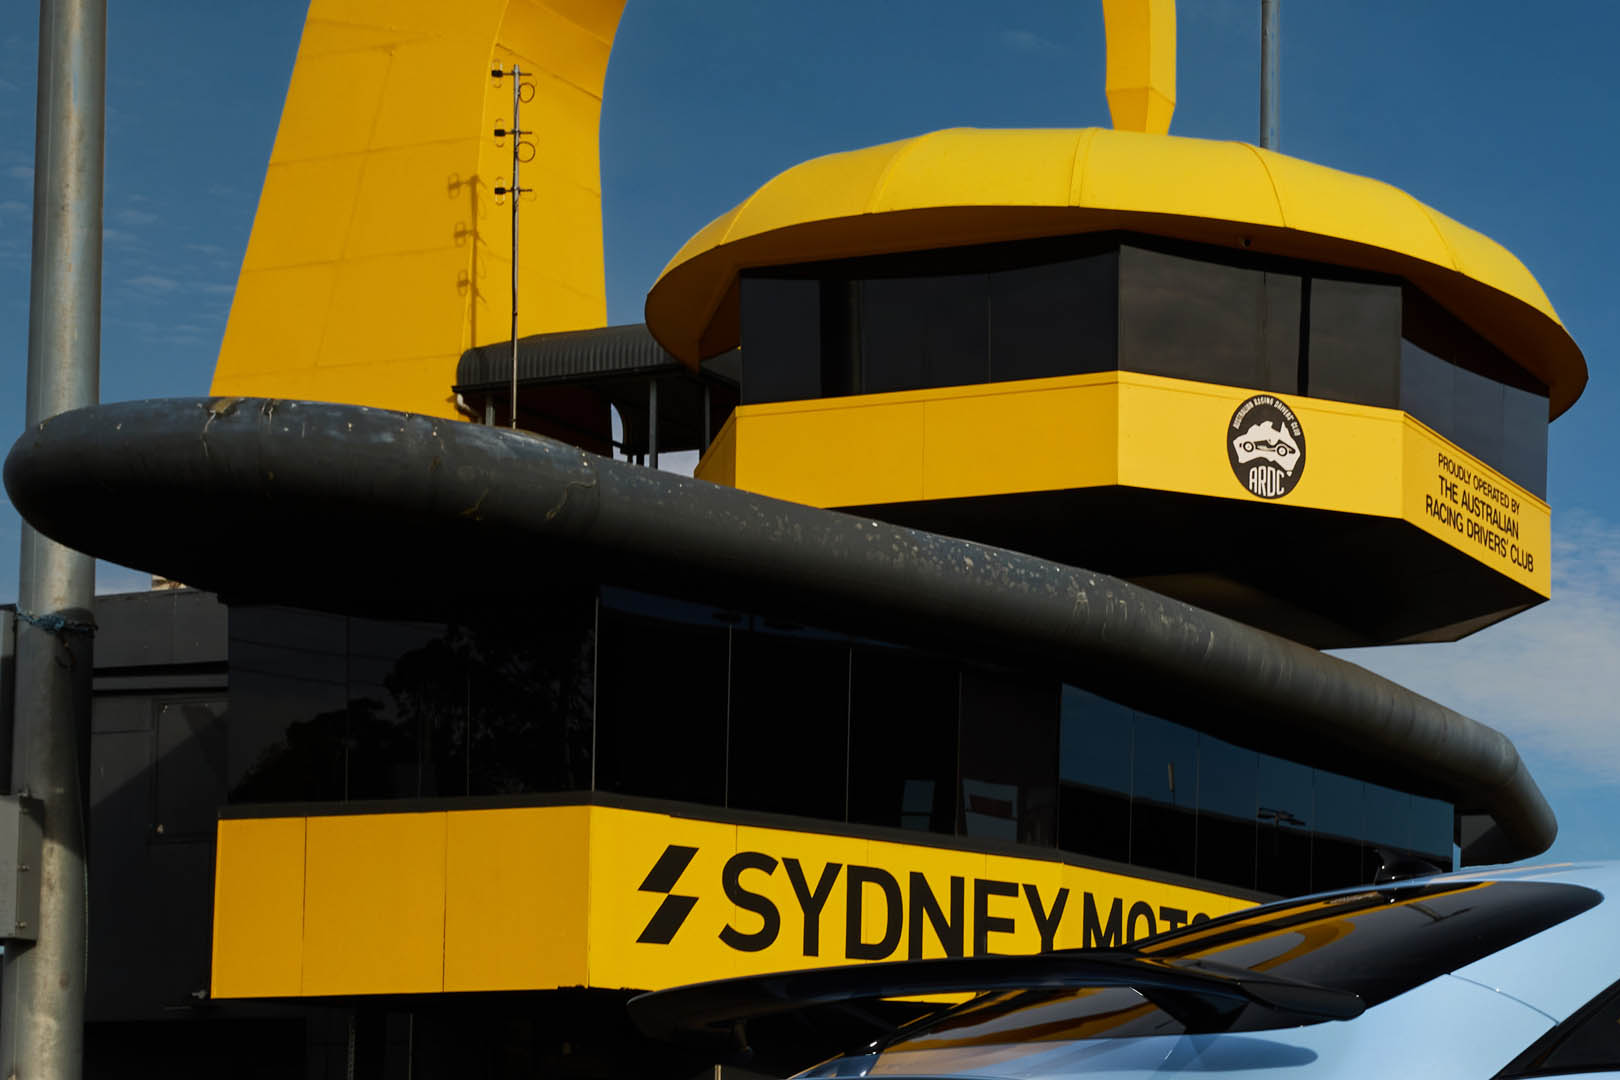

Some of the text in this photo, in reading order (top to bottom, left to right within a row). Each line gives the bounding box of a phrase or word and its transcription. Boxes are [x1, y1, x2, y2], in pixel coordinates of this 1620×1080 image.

[1249, 465, 1285, 497] ARDC
[1438, 452, 1520, 516] PROUDLY OPERATED BY
[1438, 474, 1519, 540] THE AUSTRALIAN
[1425, 494, 1534, 573] RACING DRIVERS' CLUB
[718, 851, 1211, 961] SYDNEY MOT
